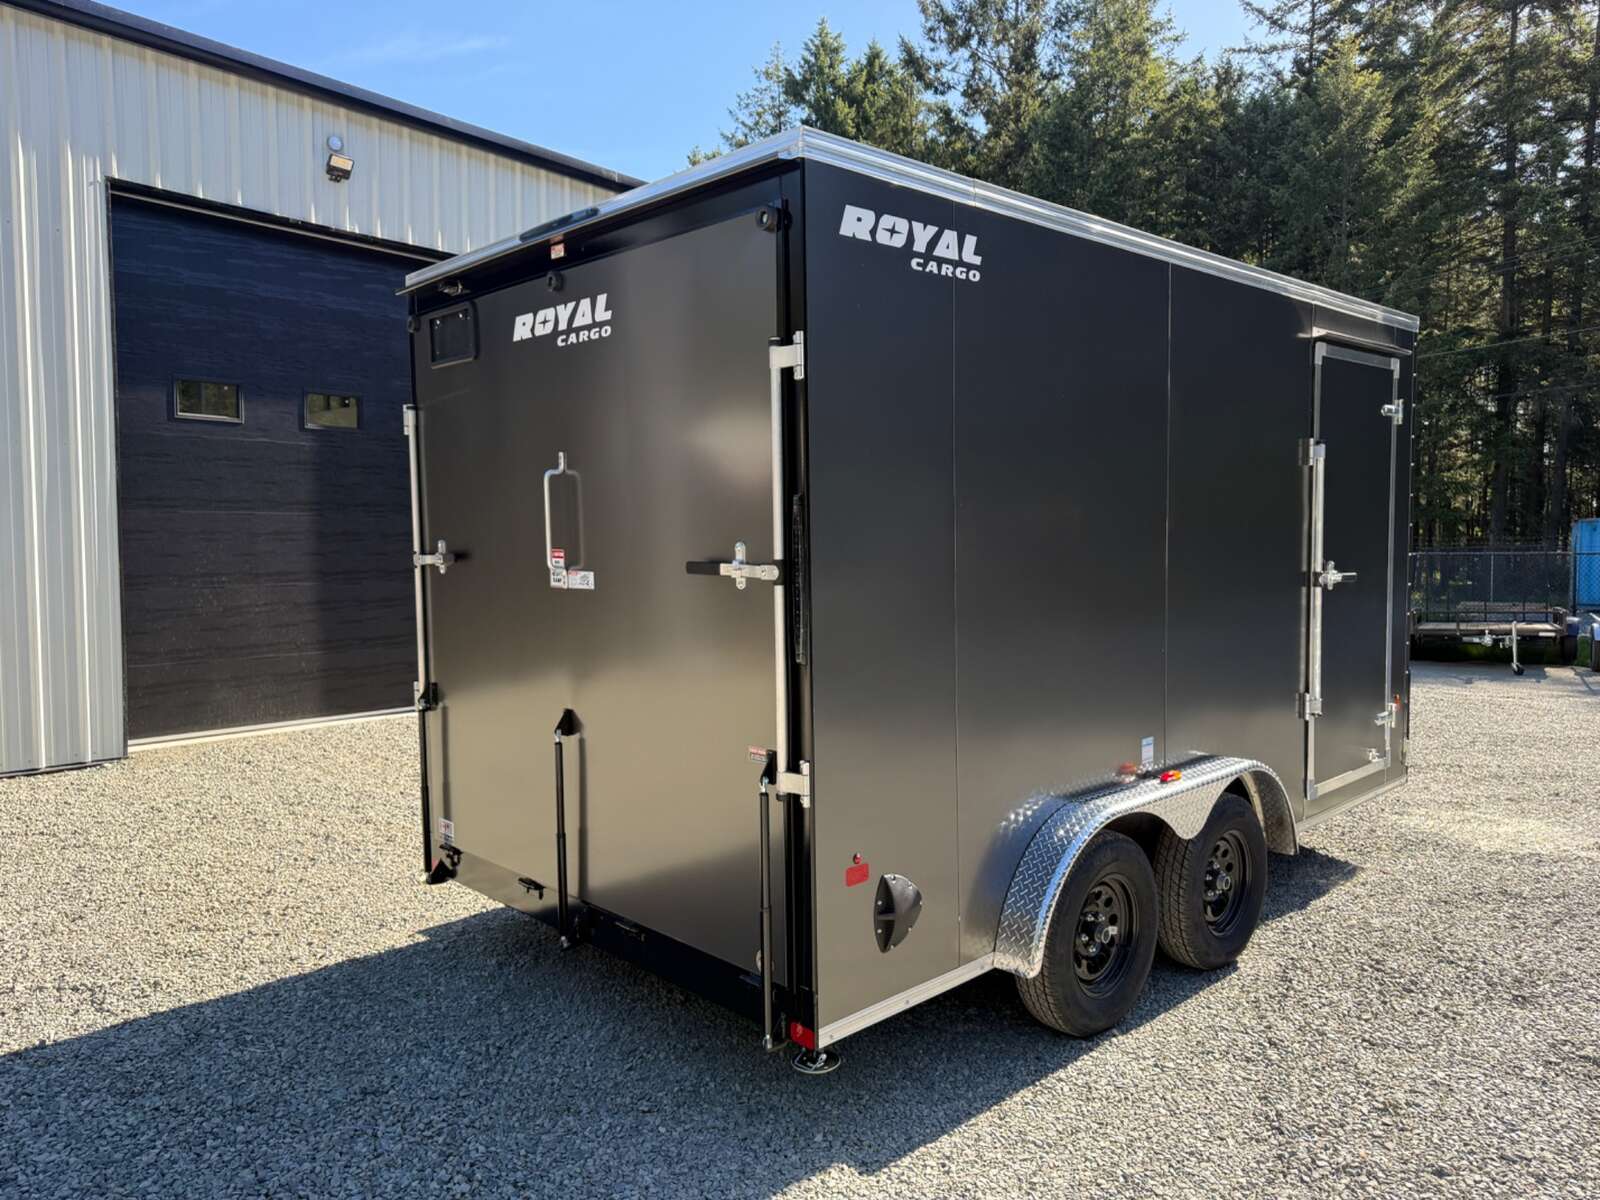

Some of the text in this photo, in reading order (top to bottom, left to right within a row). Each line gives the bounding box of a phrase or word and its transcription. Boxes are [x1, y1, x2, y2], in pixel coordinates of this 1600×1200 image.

[839, 204, 983, 266] ROYAL
[910, 257, 981, 282] CARGO
[513, 293, 612, 342] ROYAL
[557, 325, 612, 347] CARGO
